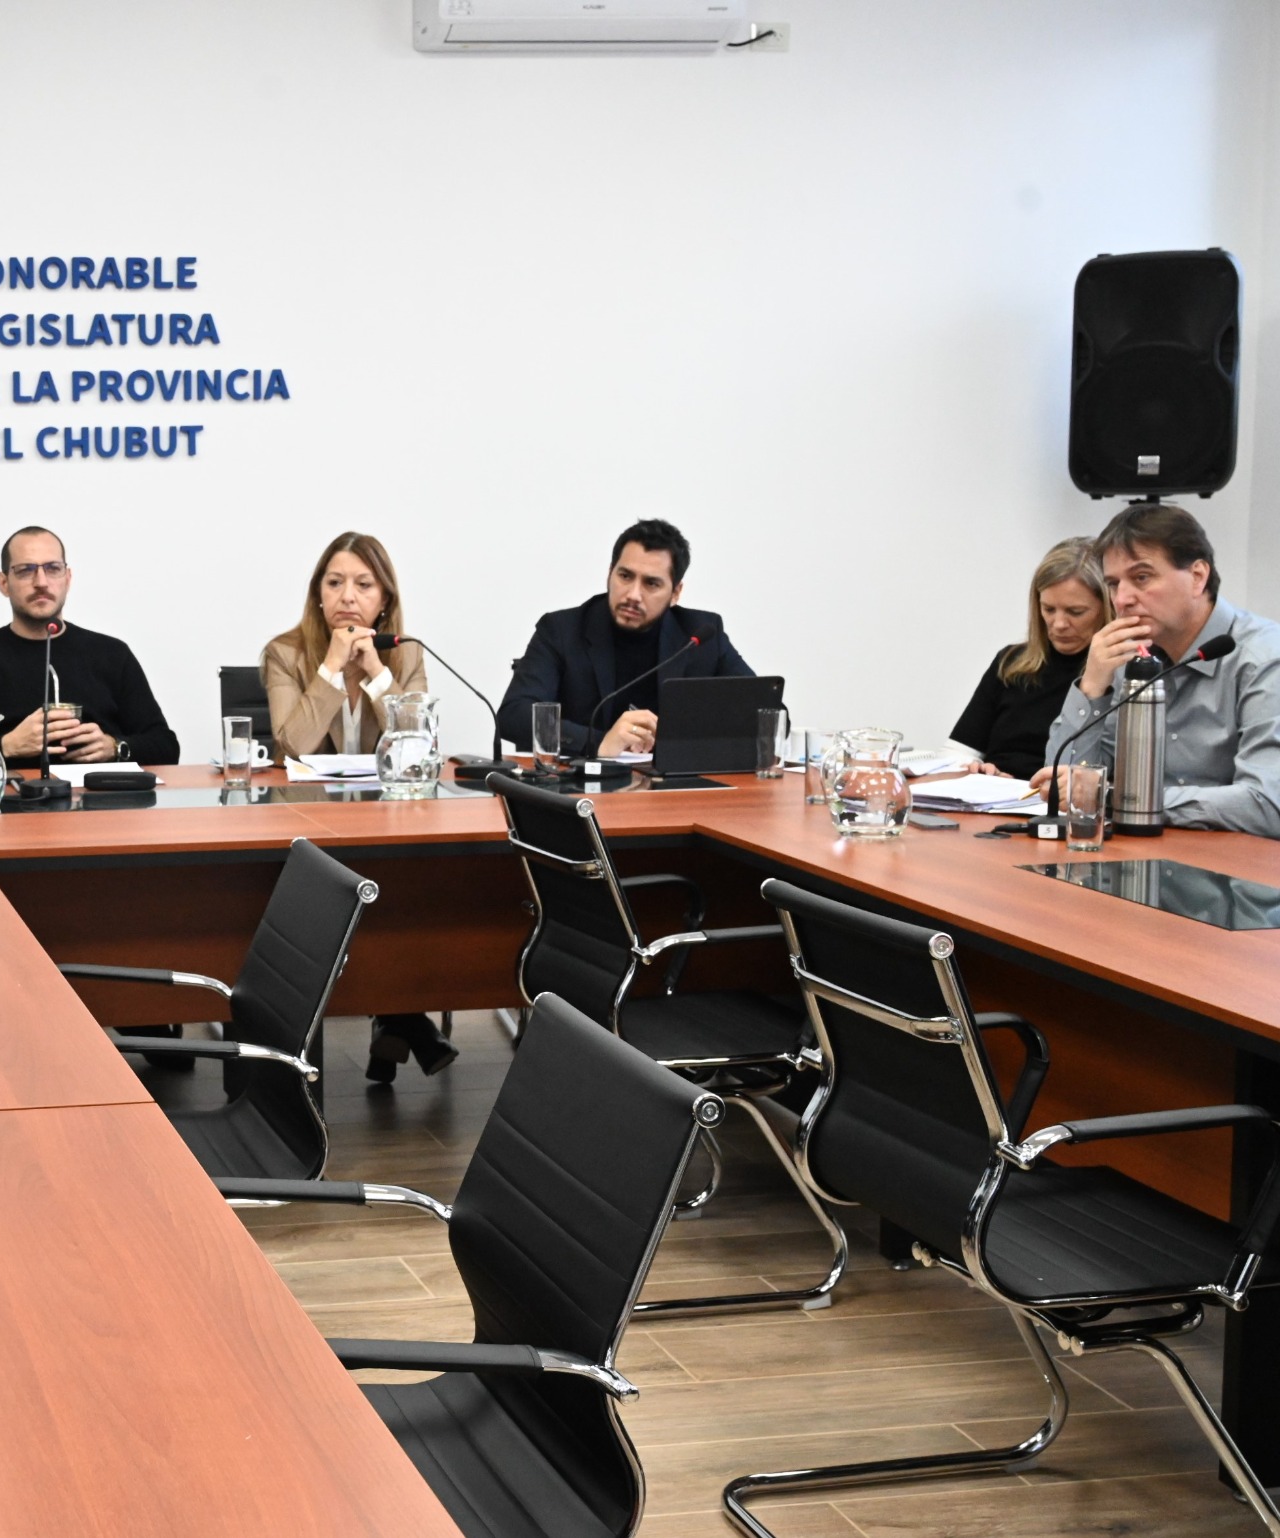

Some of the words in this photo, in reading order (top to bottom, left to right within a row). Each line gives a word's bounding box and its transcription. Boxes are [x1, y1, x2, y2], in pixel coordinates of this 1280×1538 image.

[12, 370, 59, 403] LA
[71, 368, 290, 402] PROVINCIA
[36, 425, 204, 459] CHUBUT
